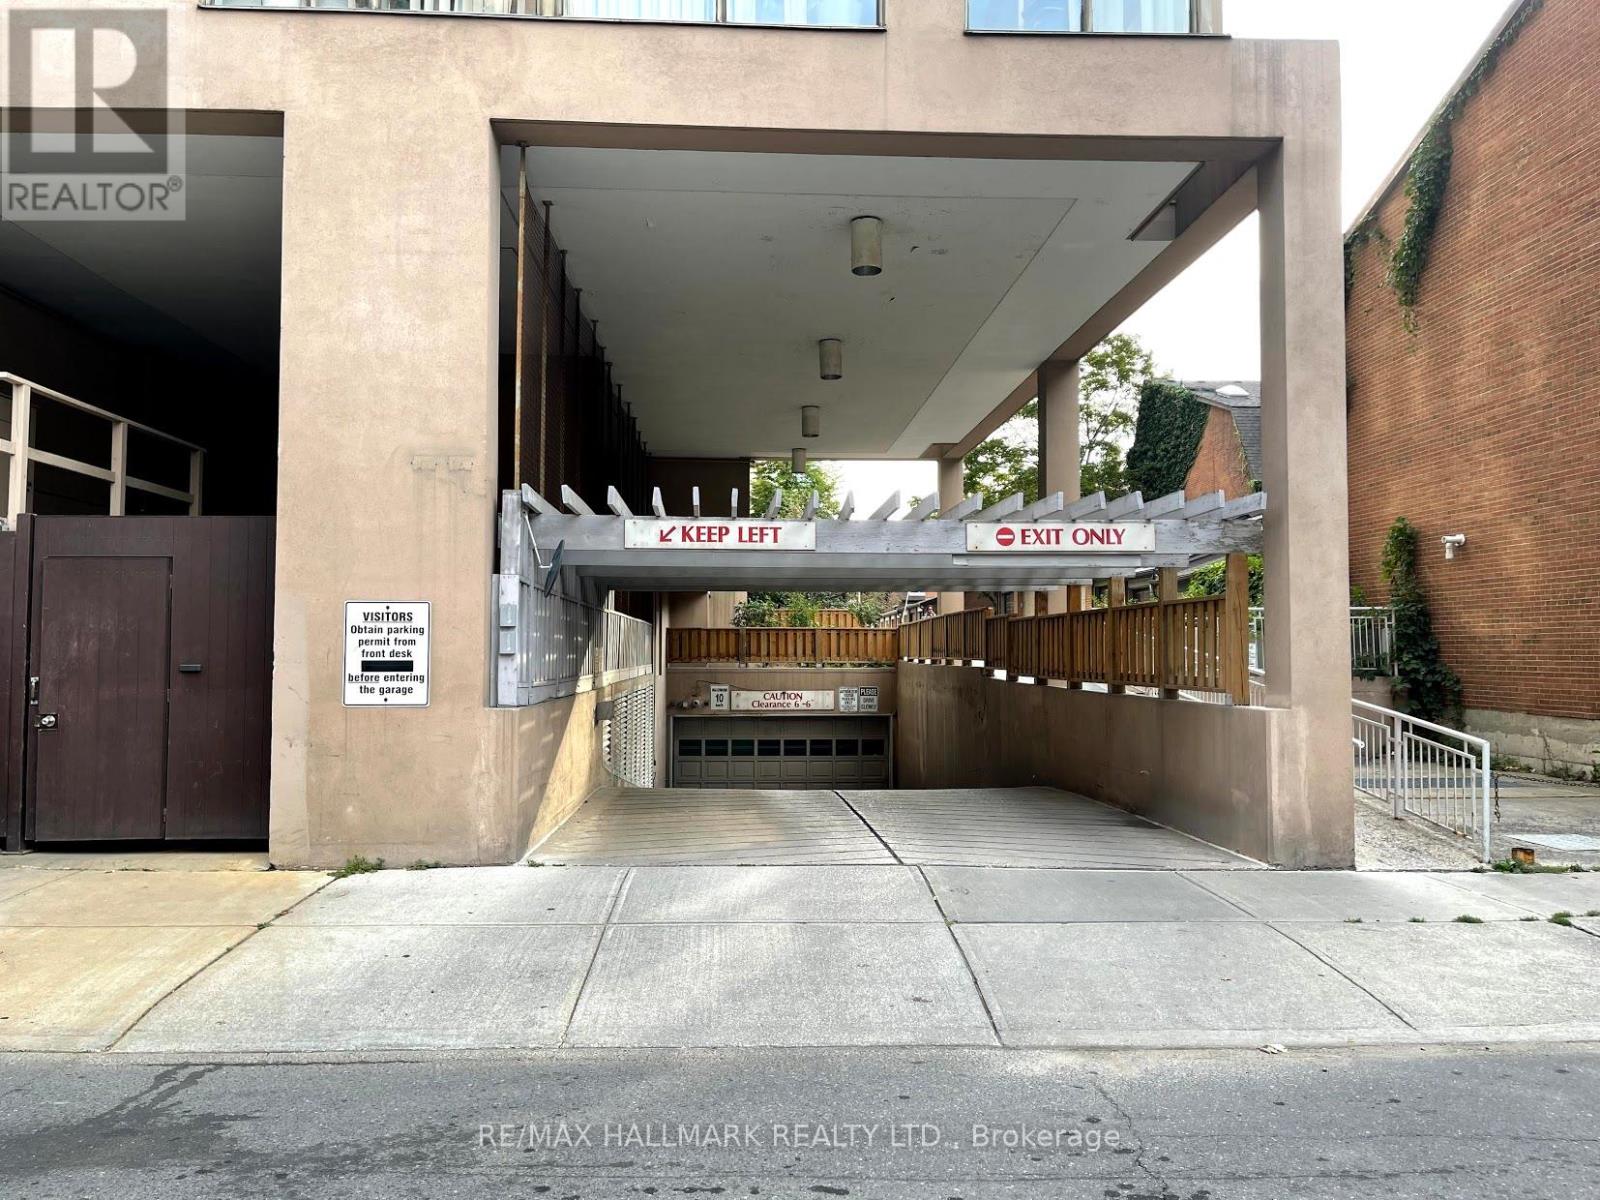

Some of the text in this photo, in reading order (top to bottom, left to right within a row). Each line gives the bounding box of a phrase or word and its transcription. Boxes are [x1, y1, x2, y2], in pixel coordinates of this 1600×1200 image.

[681, 526, 782, 544] KEEP LEFT
[1021, 528, 1126, 546] EXIT ONLY
[362, 611, 413, 622] VISITORS
[350, 625, 425, 636] Obtain parking
[358, 637, 416, 648] permit from
[361, 649, 412, 658] front desk
[347, 673, 425, 683] before entering
[359, 685, 414, 695] the garage
[715, 693, 724, 703] 10
[763, 692, 803, 701] CAUTION
[751, 700, 791, 708] Clearance
